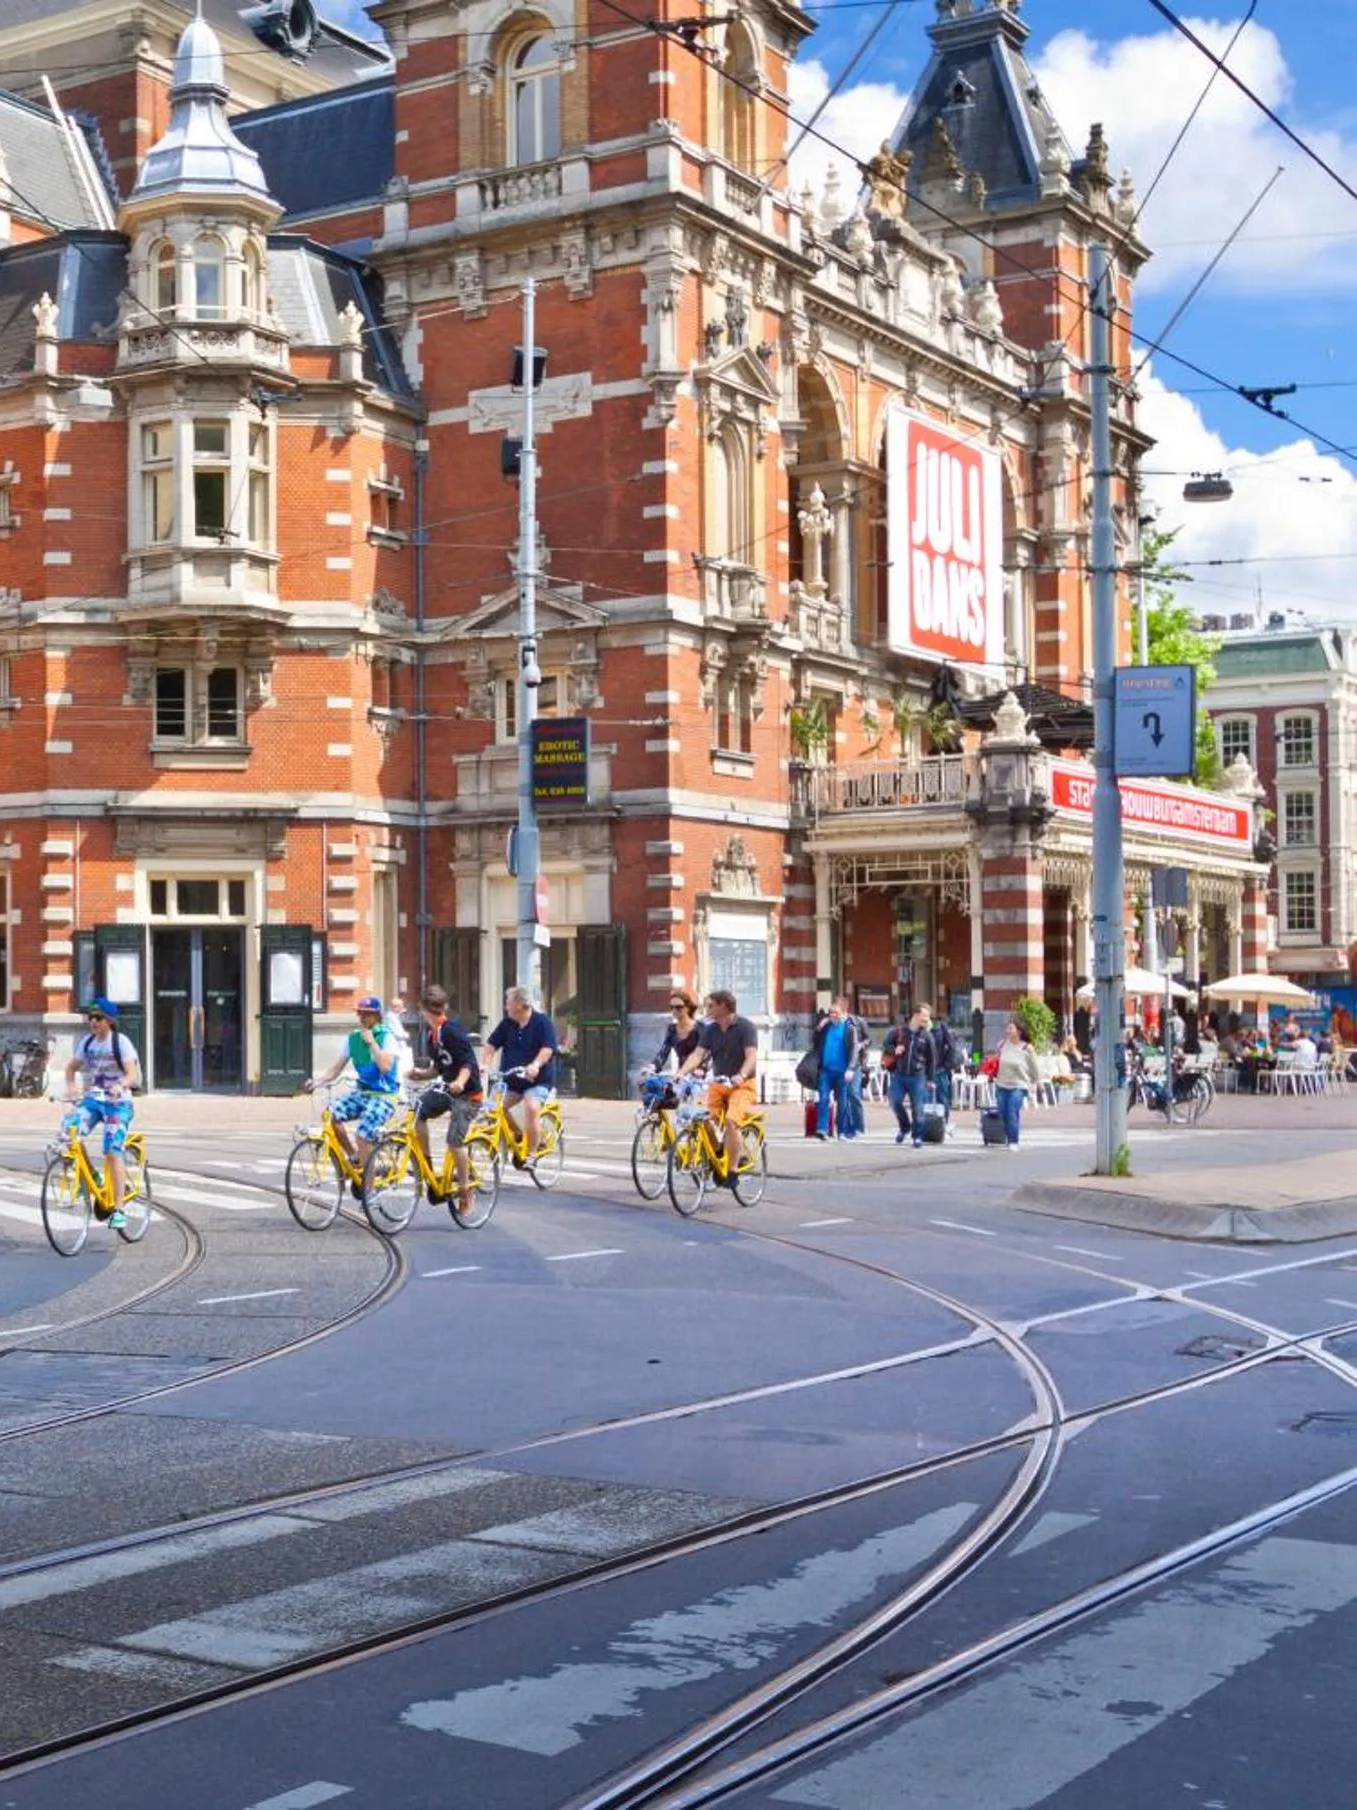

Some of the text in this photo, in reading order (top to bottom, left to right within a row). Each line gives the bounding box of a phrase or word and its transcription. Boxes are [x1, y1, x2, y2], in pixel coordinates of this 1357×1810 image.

[911, 441, 981, 568] JULI
[912, 548, 985, 648] DANS
[534, 751, 586, 764] MASSAGE
[538, 739, 580, 752] EROTIC
